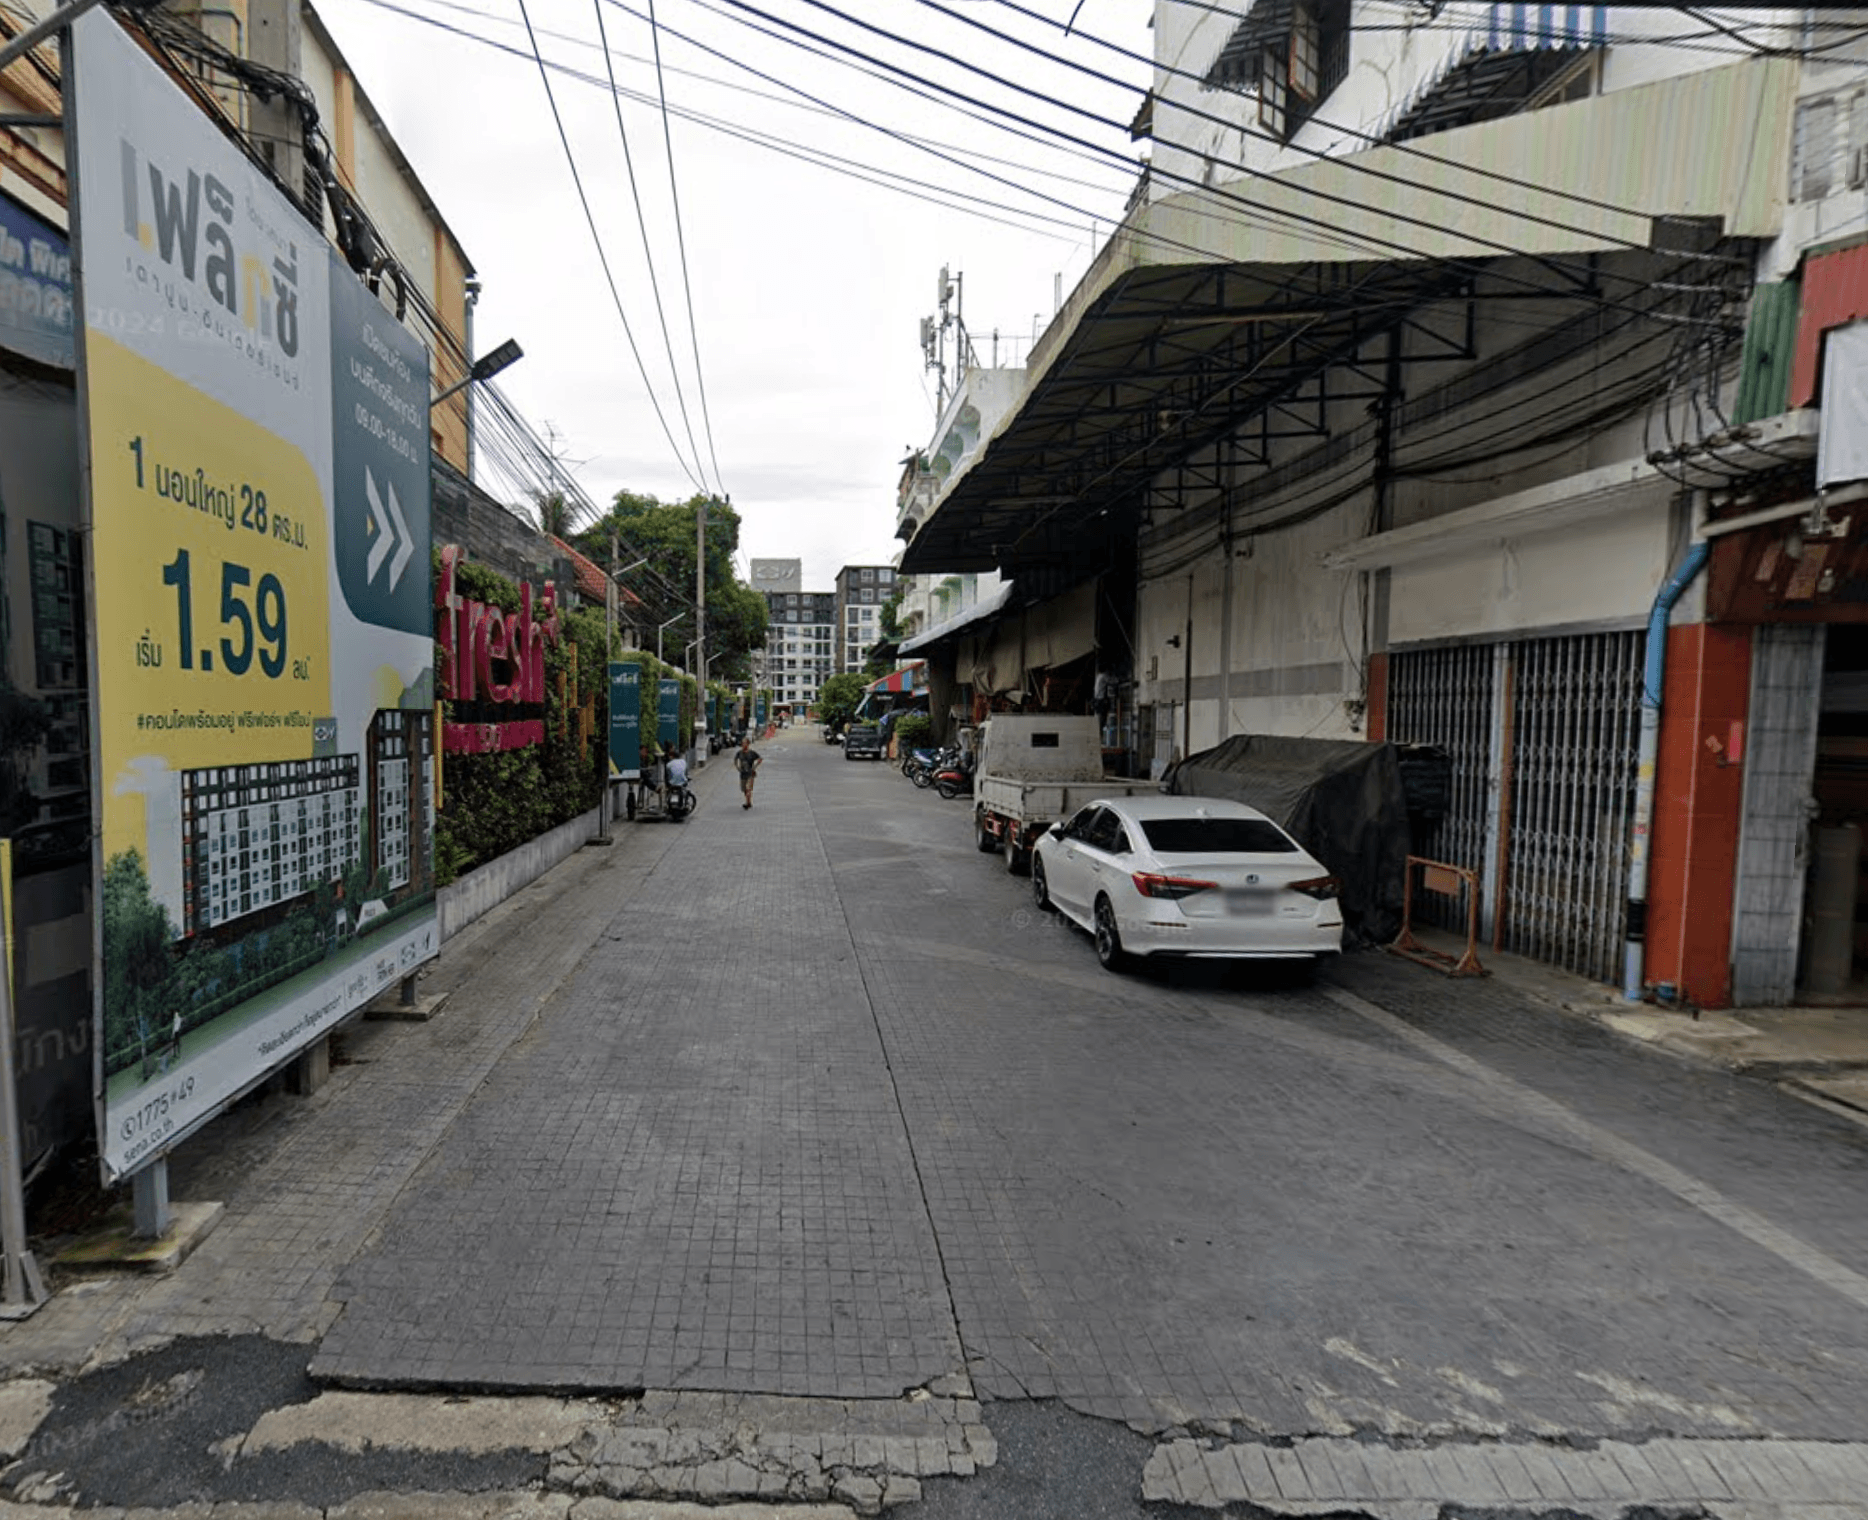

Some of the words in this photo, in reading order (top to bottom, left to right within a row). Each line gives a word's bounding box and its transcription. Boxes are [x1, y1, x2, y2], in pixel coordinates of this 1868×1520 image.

[129, 435, 145, 489] 1
[155, 467, 237, 531] นอนใหญ่
[240, 484, 268, 535] 28
[272, 513, 309, 550] ตร.ม.
[136, 627, 163, 668] เริ่ม
[162, 546, 288, 680] 1.59
[136, 708, 236, 734] #คอนโดพร้อมอยู่
[123, 1116, 175, 1164] sena.co.th
